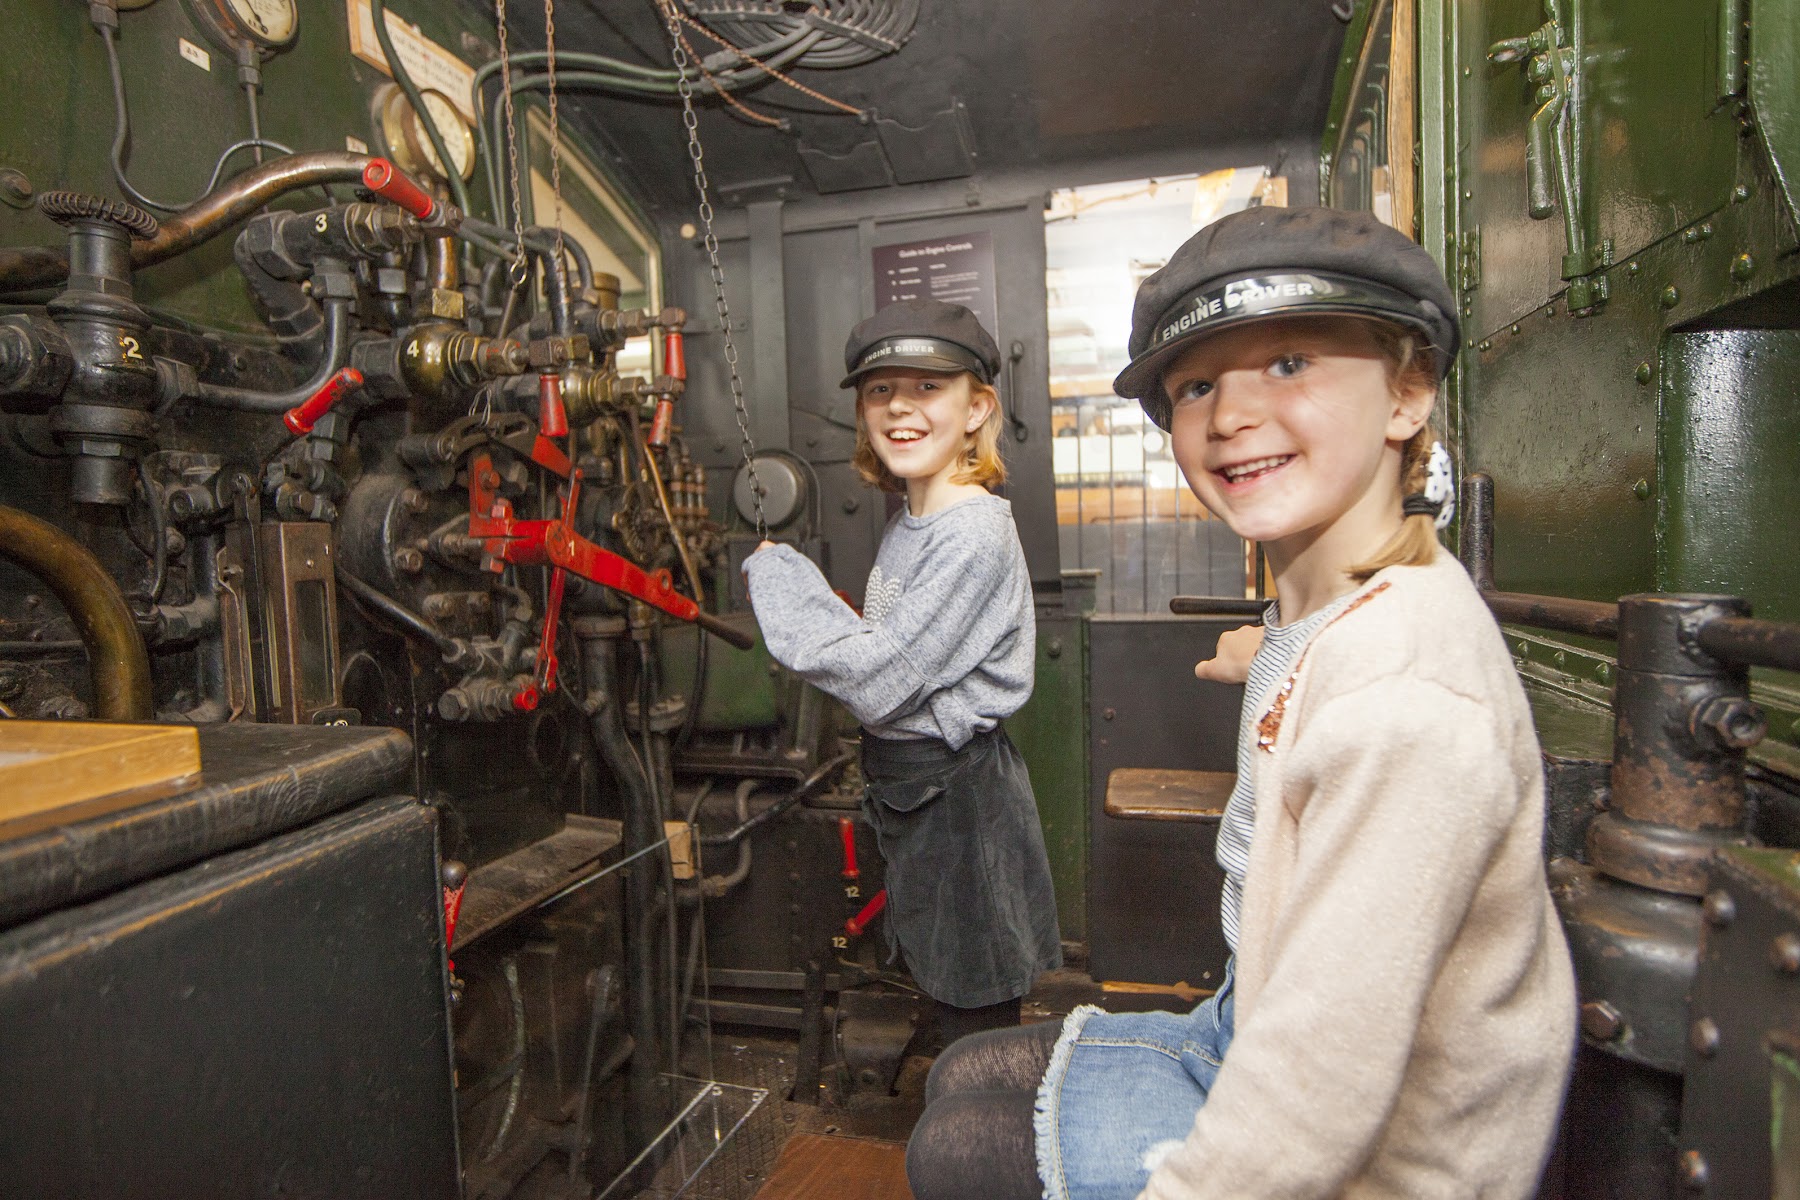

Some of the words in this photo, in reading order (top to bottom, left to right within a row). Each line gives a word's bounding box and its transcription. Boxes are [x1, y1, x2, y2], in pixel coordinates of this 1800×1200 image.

[315, 213, 328, 233] 3
[925, 246, 945, 255] Engine
[1162, 298, 1222, 341] ENGINE
[1225, 282, 1314, 309] DRIVER
[123, 336, 143, 360] 2
[406, 339, 420, 357] 4
[865, 347, 891, 364] ENGINE
[895, 345, 935, 354] DRIVER
[568, 540, 575, 557] 1
[844, 886, 860, 898] 12
[831, 936, 848, 949] 12
